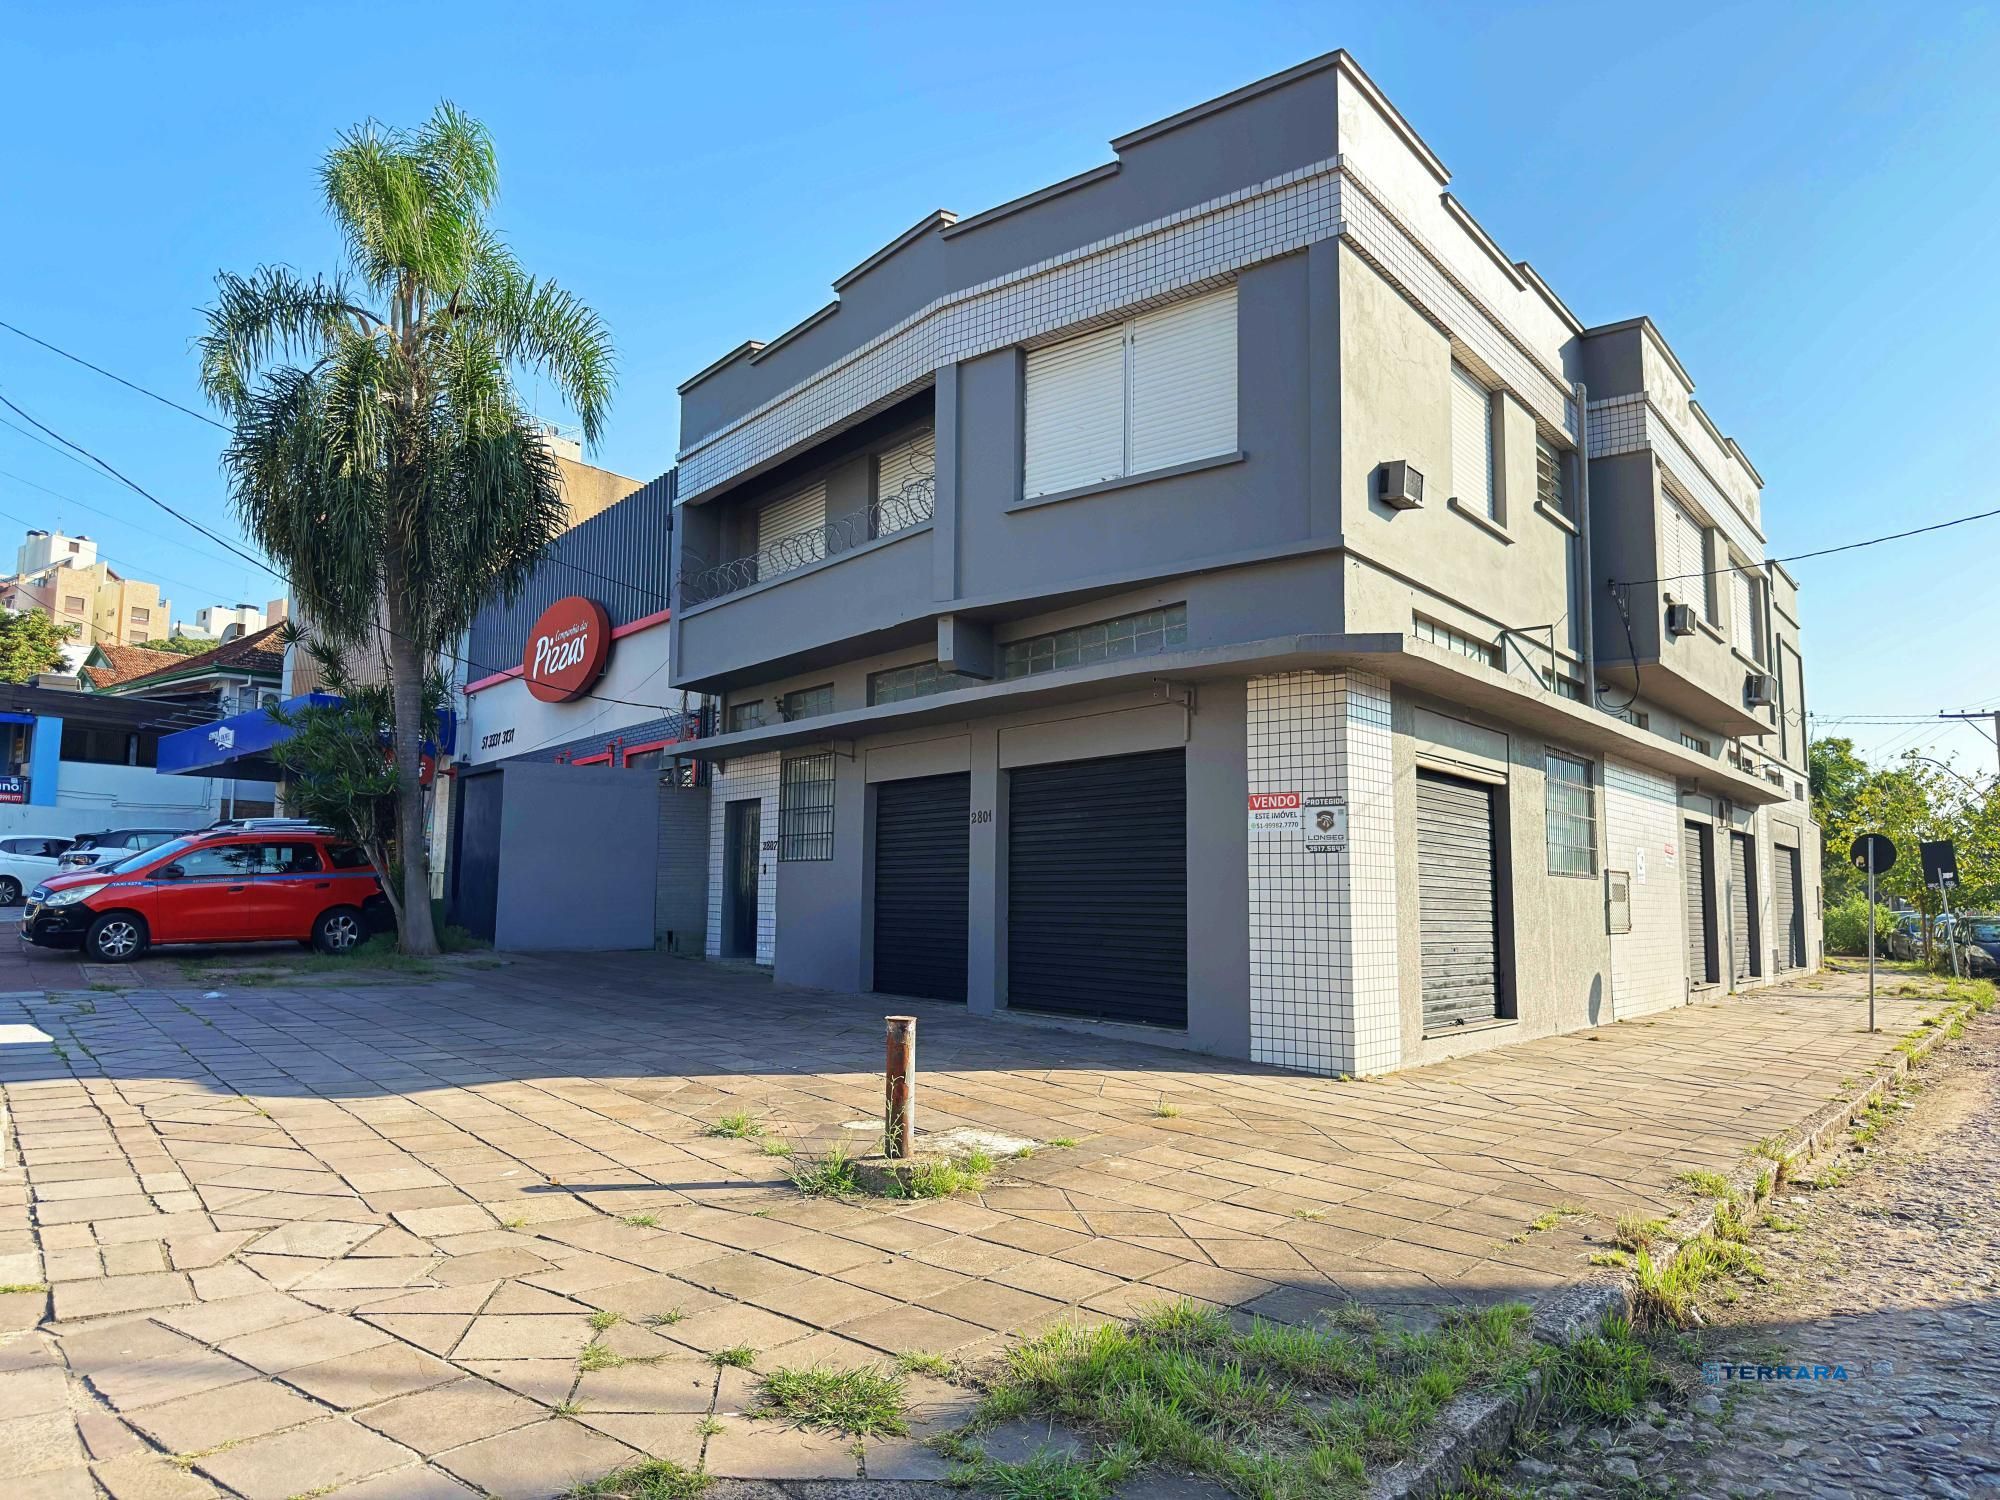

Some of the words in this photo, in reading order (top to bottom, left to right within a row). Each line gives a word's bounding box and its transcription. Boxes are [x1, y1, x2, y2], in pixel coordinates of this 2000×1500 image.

[532, 634, 588, 680] Pizzas
[1252, 795, 1297, 808] VENDO
[1305, 798, 1345, 806] PROTEGIDO
[971, 809, 992, 824] 2801
[1255, 812, 1270, 820] ESTE
[1271, 810, 1298, 819] IMÓVEL
